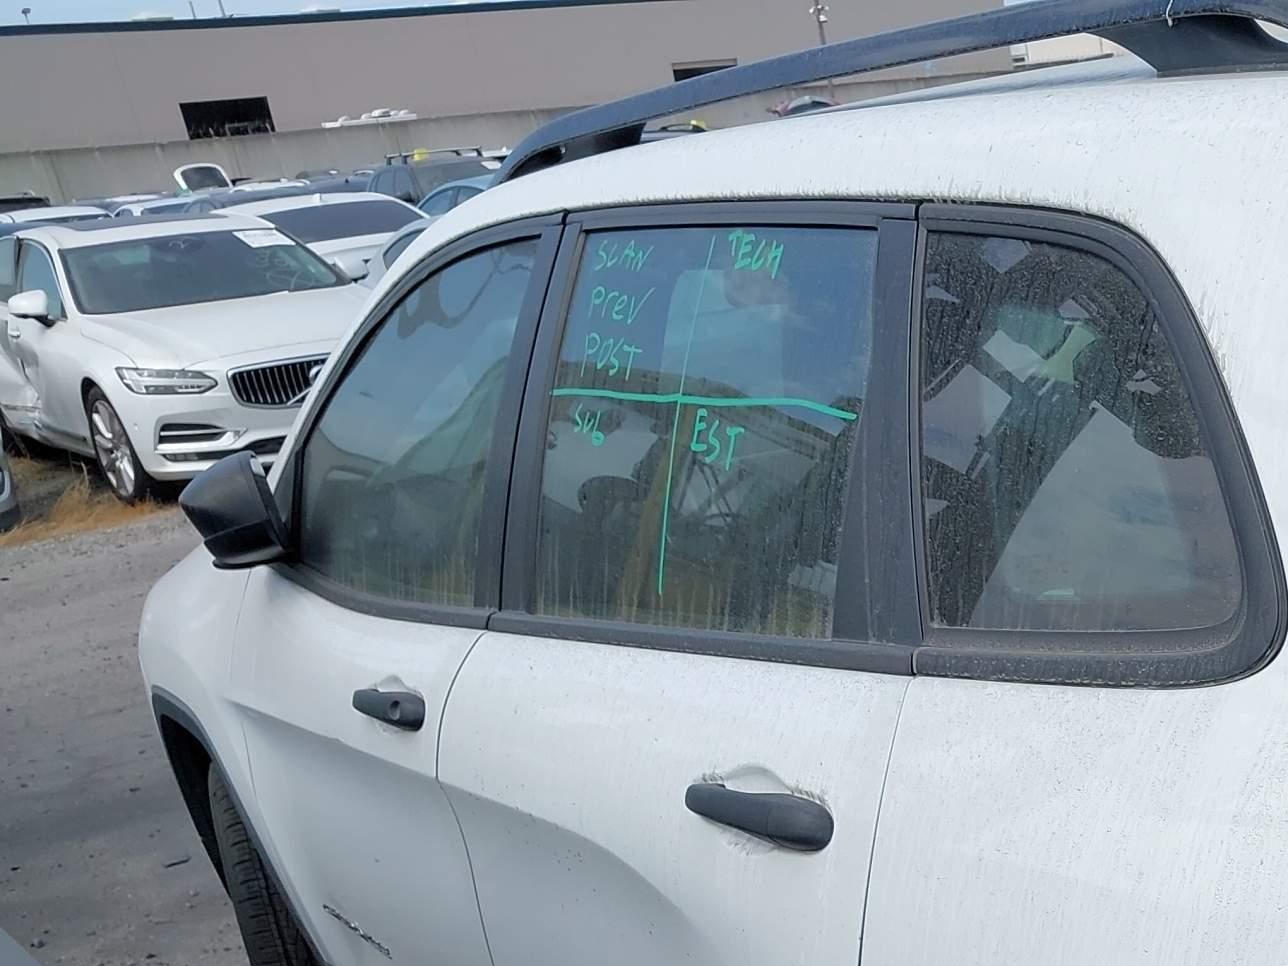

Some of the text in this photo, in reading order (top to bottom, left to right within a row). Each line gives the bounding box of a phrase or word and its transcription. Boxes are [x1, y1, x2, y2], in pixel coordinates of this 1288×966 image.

[728, 230, 784, 280] TECH
[580, 332, 642, 381] POST
[690, 407, 745, 472] EST
